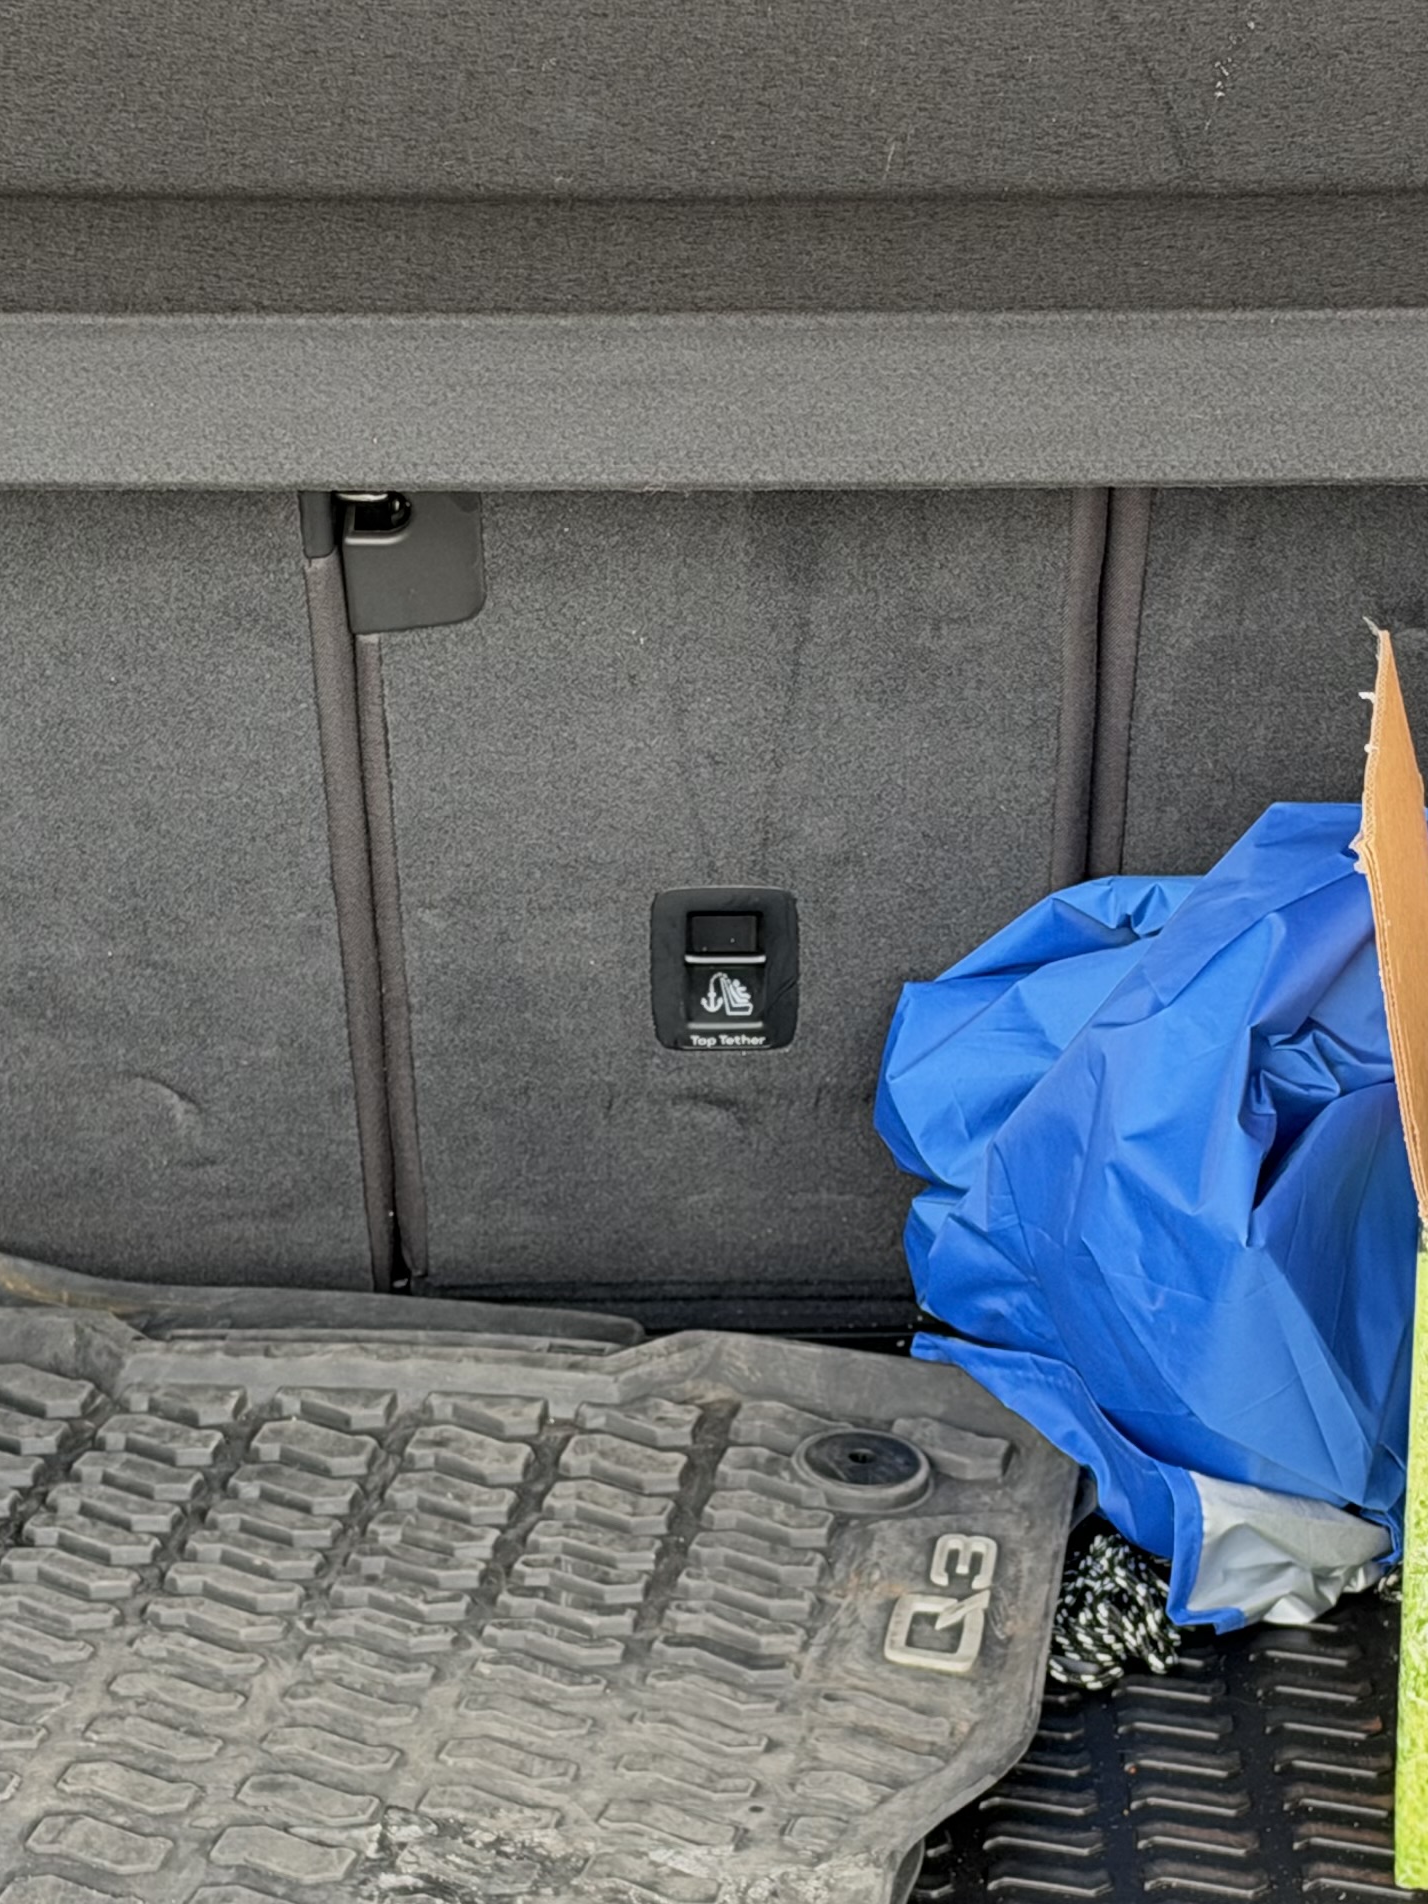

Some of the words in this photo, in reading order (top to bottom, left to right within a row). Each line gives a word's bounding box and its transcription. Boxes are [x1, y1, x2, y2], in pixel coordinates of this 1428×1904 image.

[690, 1035, 716, 1048] Top
[719, 1034, 766, 1046] Tether
[884, 1533, 998, 1673] Q3
